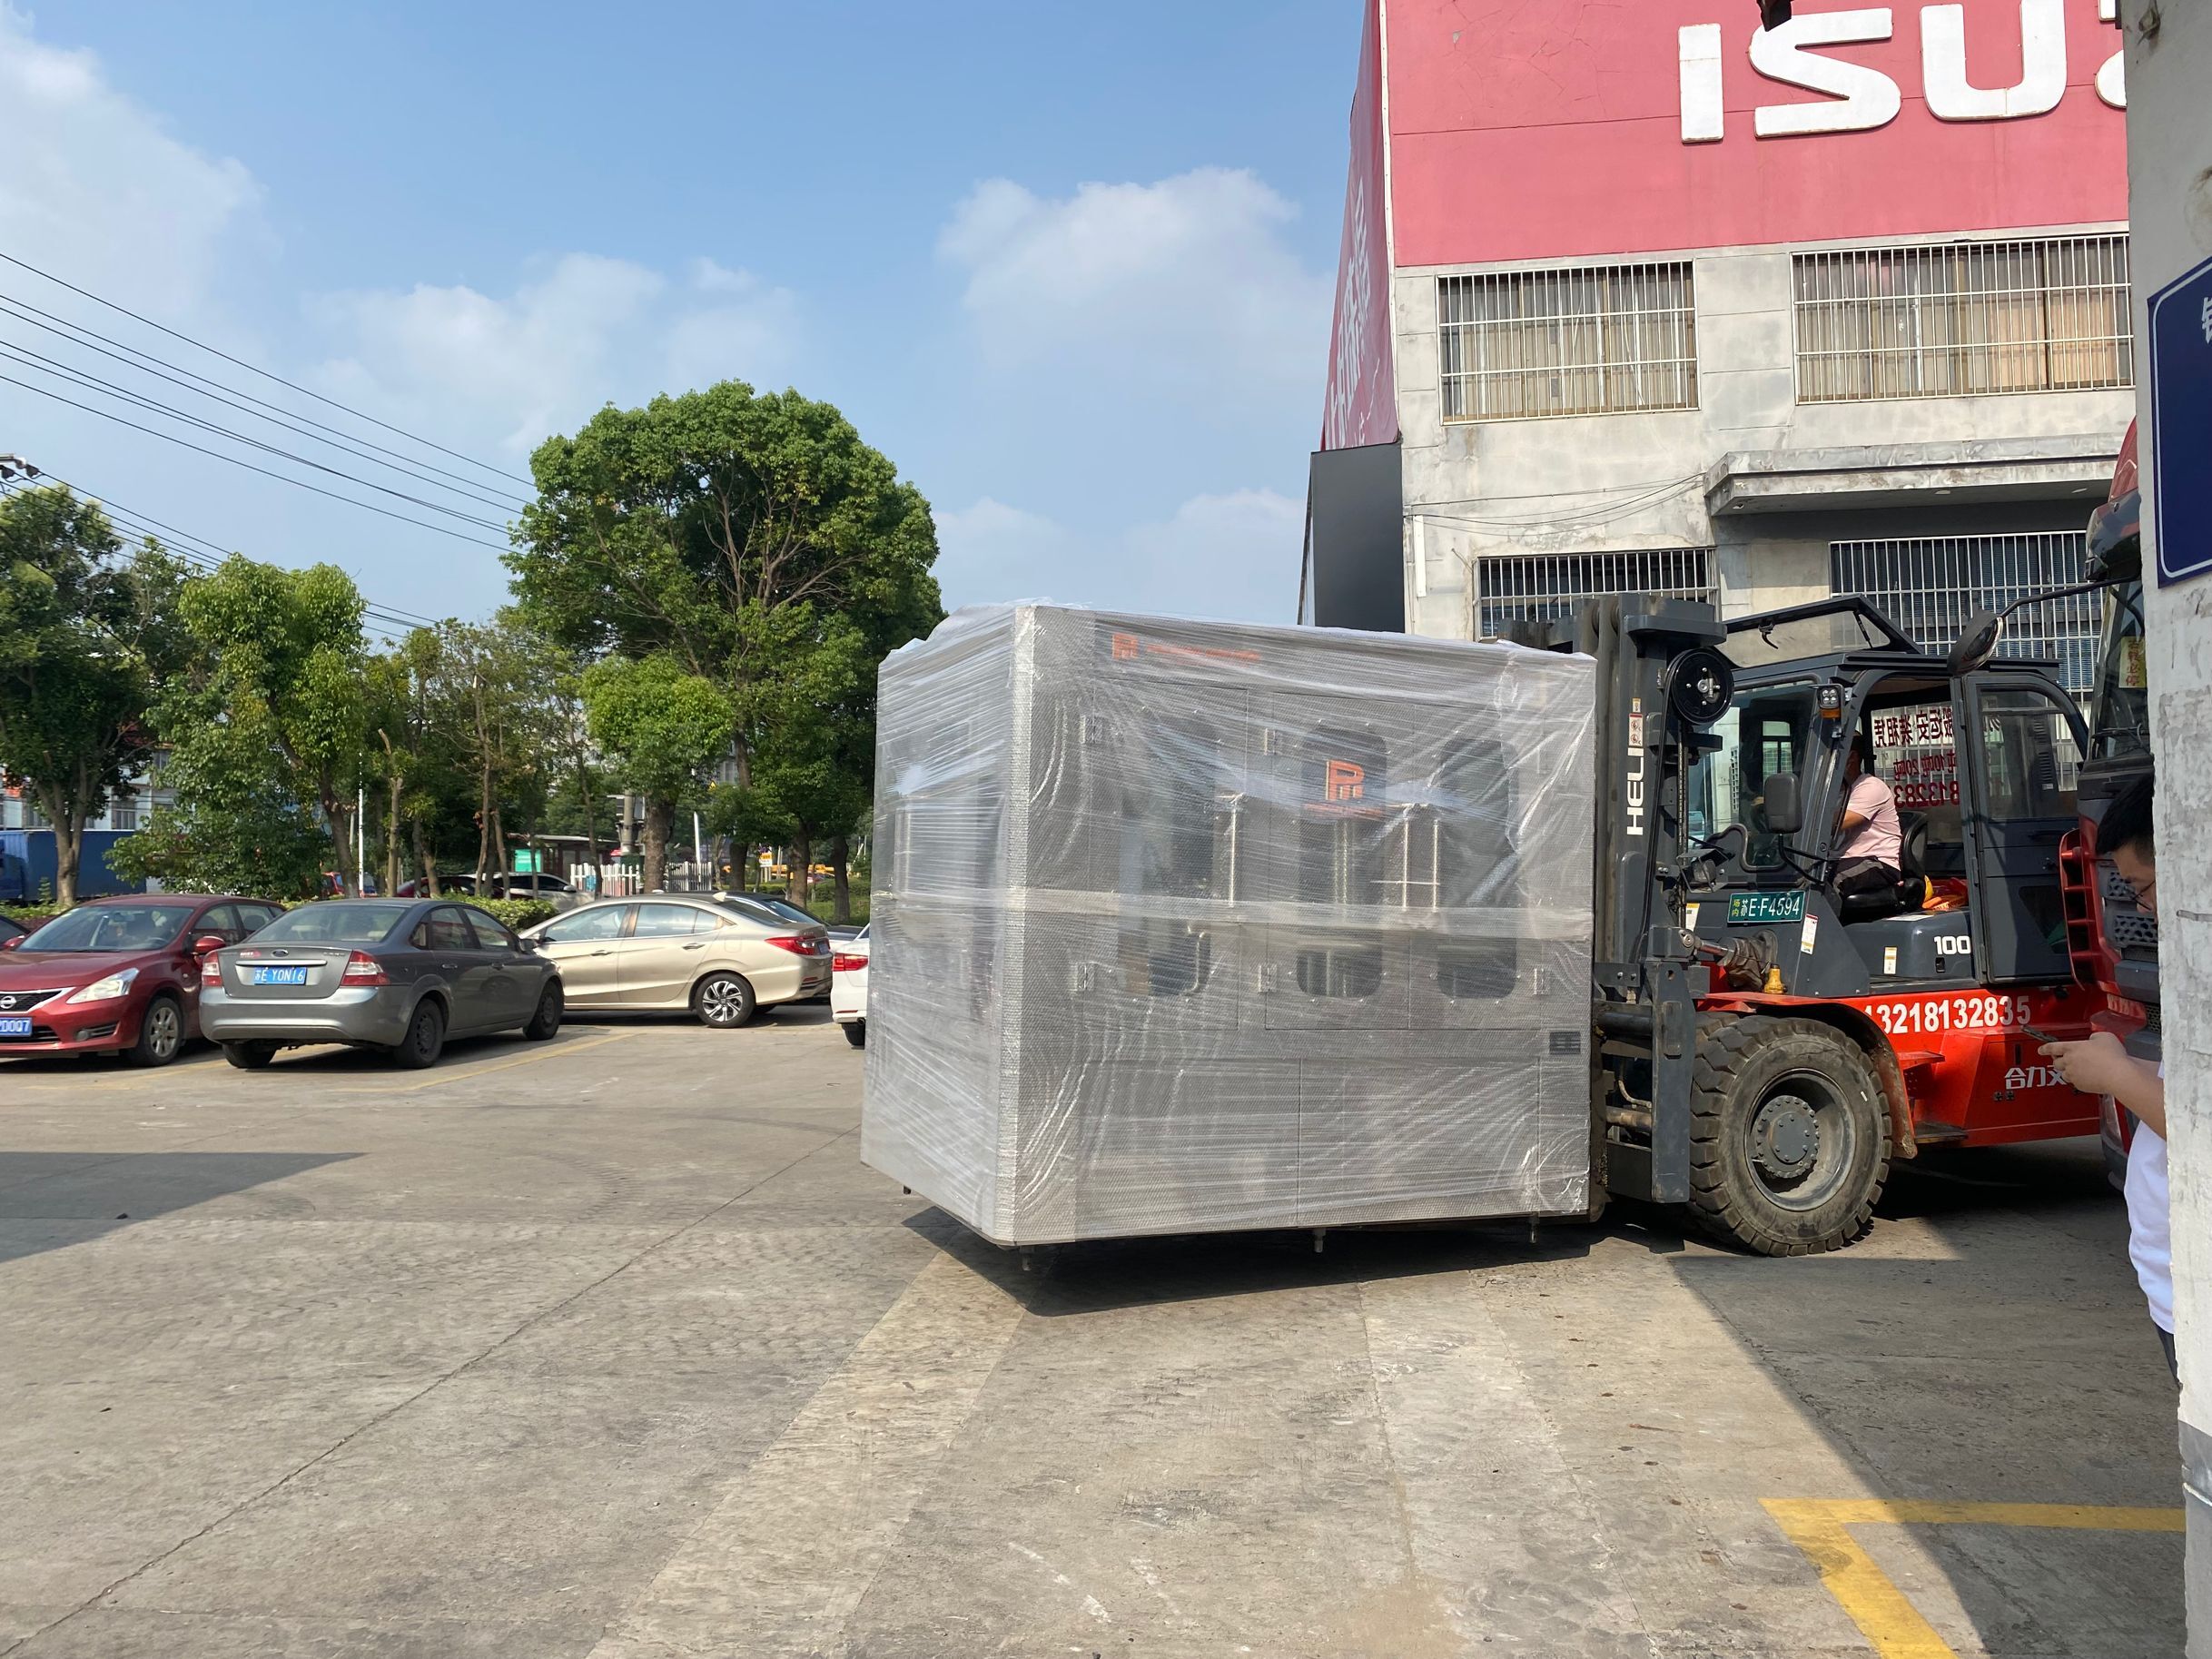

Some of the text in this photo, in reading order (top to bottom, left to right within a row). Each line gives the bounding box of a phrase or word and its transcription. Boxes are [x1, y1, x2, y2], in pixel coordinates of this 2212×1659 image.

[1678, 0, 2128, 145] ISU
[1626, 746, 1644, 835] HELI
[1934, 935, 1971, 955] 100
